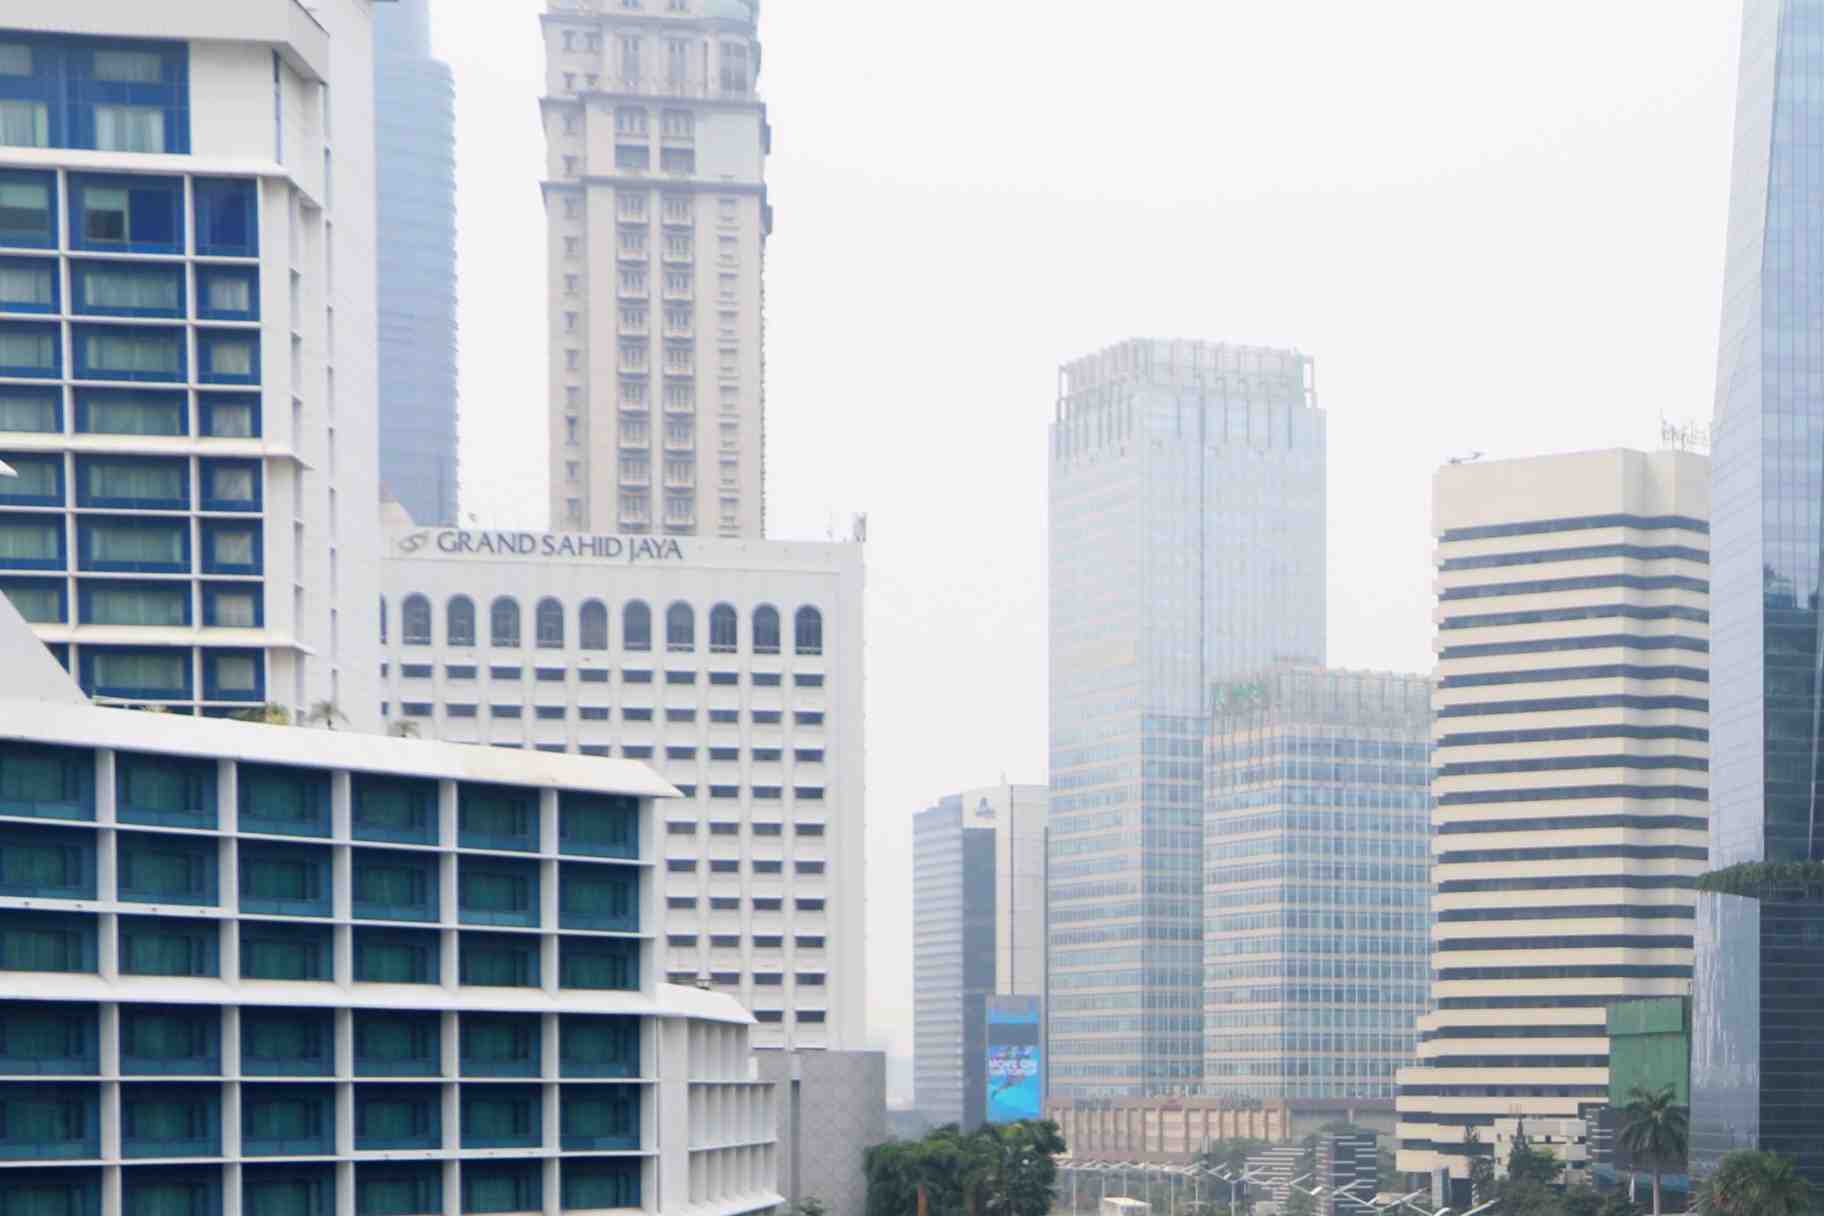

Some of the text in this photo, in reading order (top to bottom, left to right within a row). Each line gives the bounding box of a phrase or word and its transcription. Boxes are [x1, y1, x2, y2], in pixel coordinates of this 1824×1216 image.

[437, 530, 683, 563] GRAND SAHID JAYA
